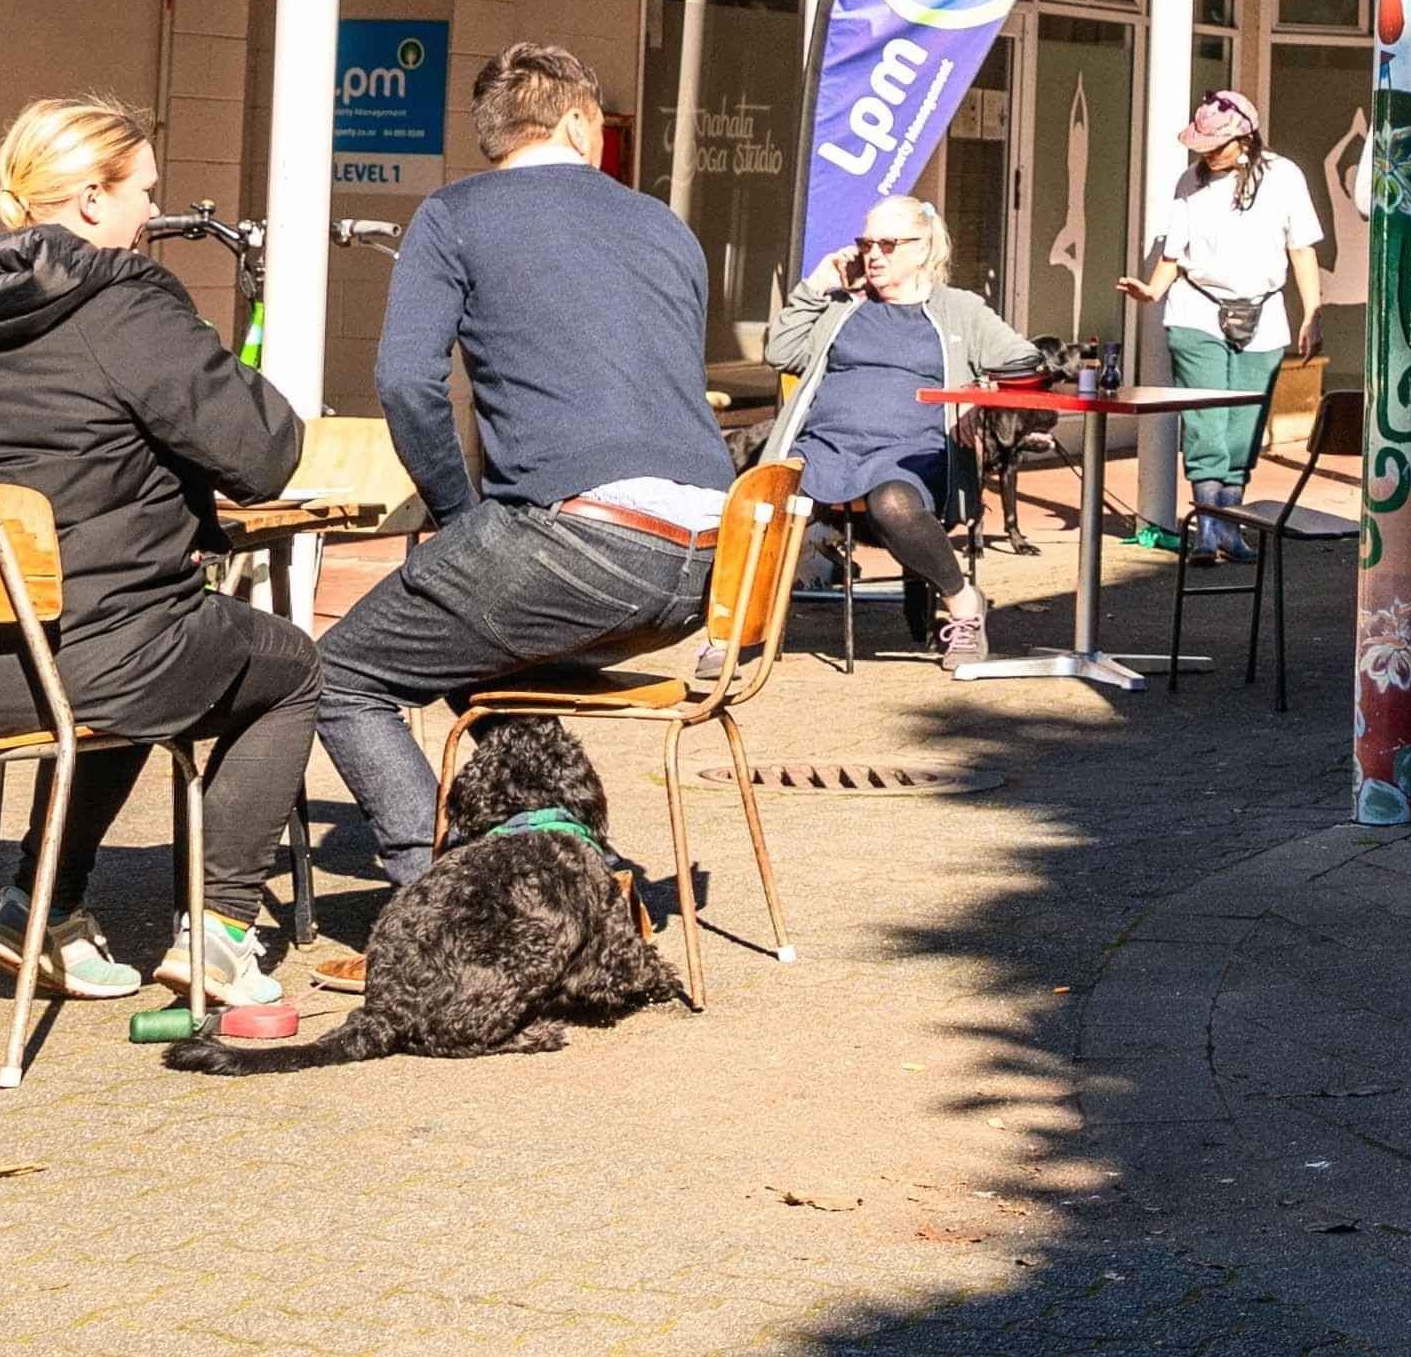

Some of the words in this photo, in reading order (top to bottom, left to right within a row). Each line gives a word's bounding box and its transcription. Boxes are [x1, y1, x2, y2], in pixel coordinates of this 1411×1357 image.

[334, 67, 406, 106] pm
[334, 164, 388, 183] LEVEL
[392, 165, 401, 183] 1
